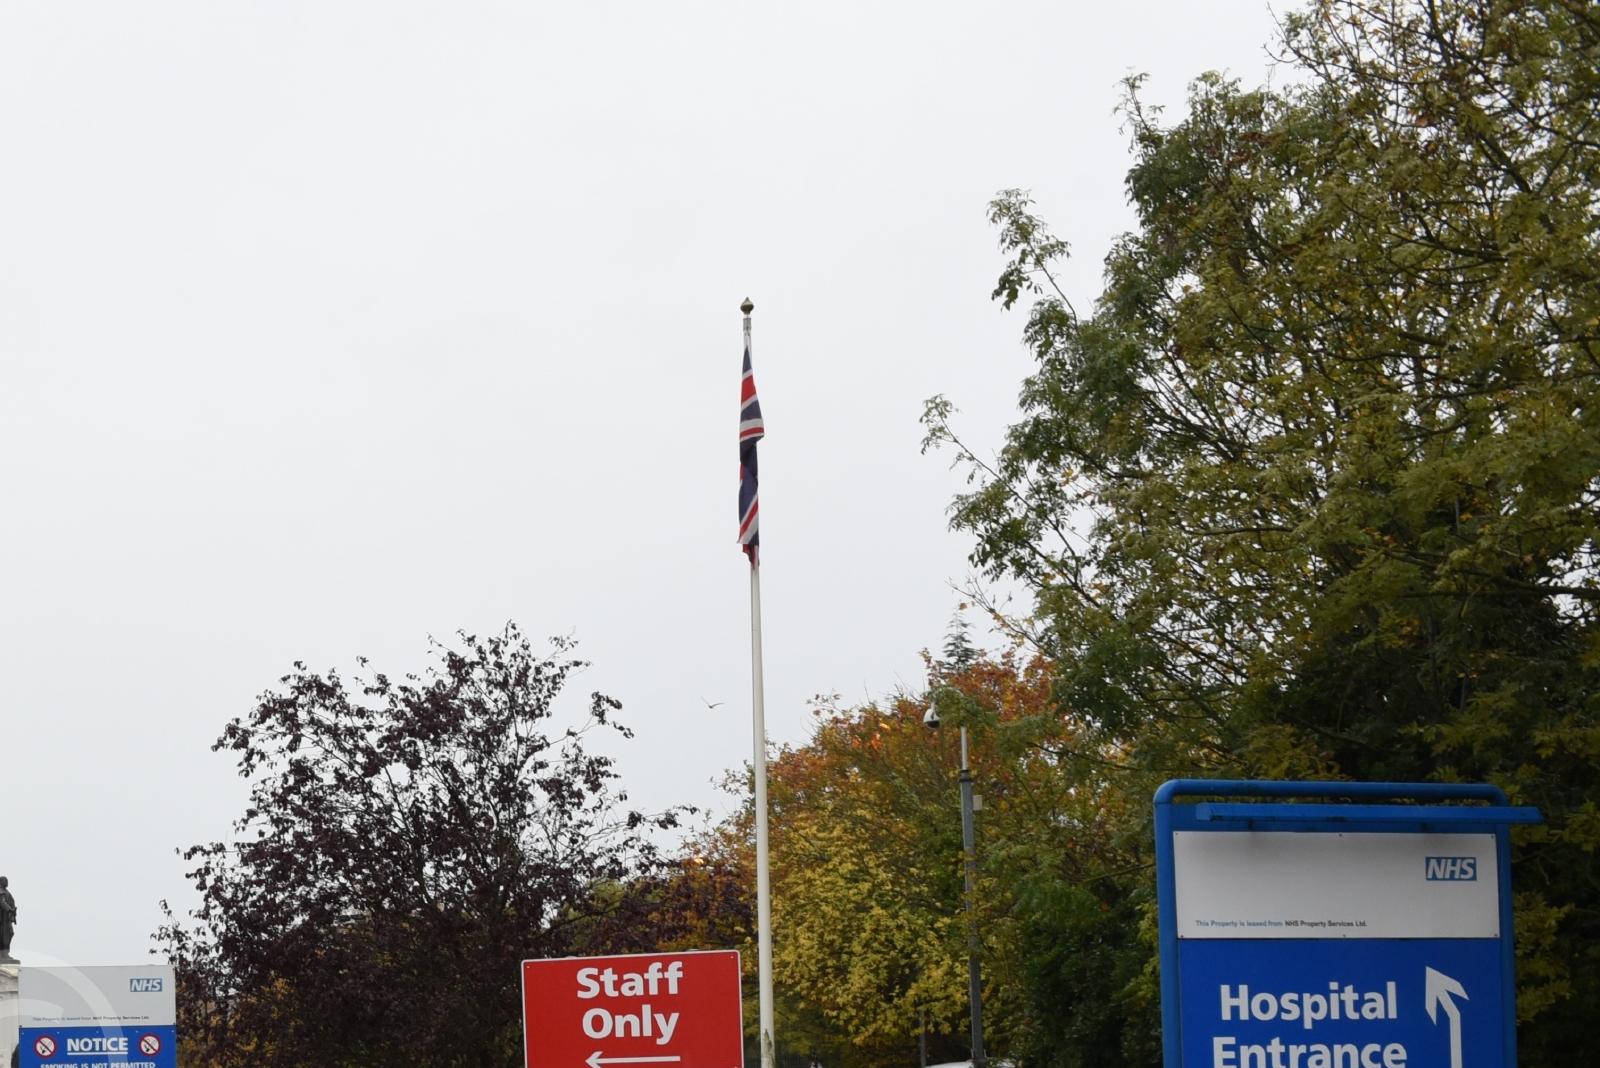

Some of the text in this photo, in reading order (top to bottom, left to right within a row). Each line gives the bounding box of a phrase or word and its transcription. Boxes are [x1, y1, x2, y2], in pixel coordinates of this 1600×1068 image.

[1426, 857, 1476, 880] NHS
[1195, 919, 1209, 927] This
[1210, 919, 1238, 929] Property
[1285, 919, 1299, 927] NHS
[1300, 919, 1327, 929] Property
[1328, 919, 1354, 927] Services
[130, 979, 162, 992] NHS
[576, 961, 683, 999] Staff
[1220, 981, 1397, 1029] Hospital
[582, 1004, 680, 1045] Only
[67, 1037, 129, 1052] NOTICE
